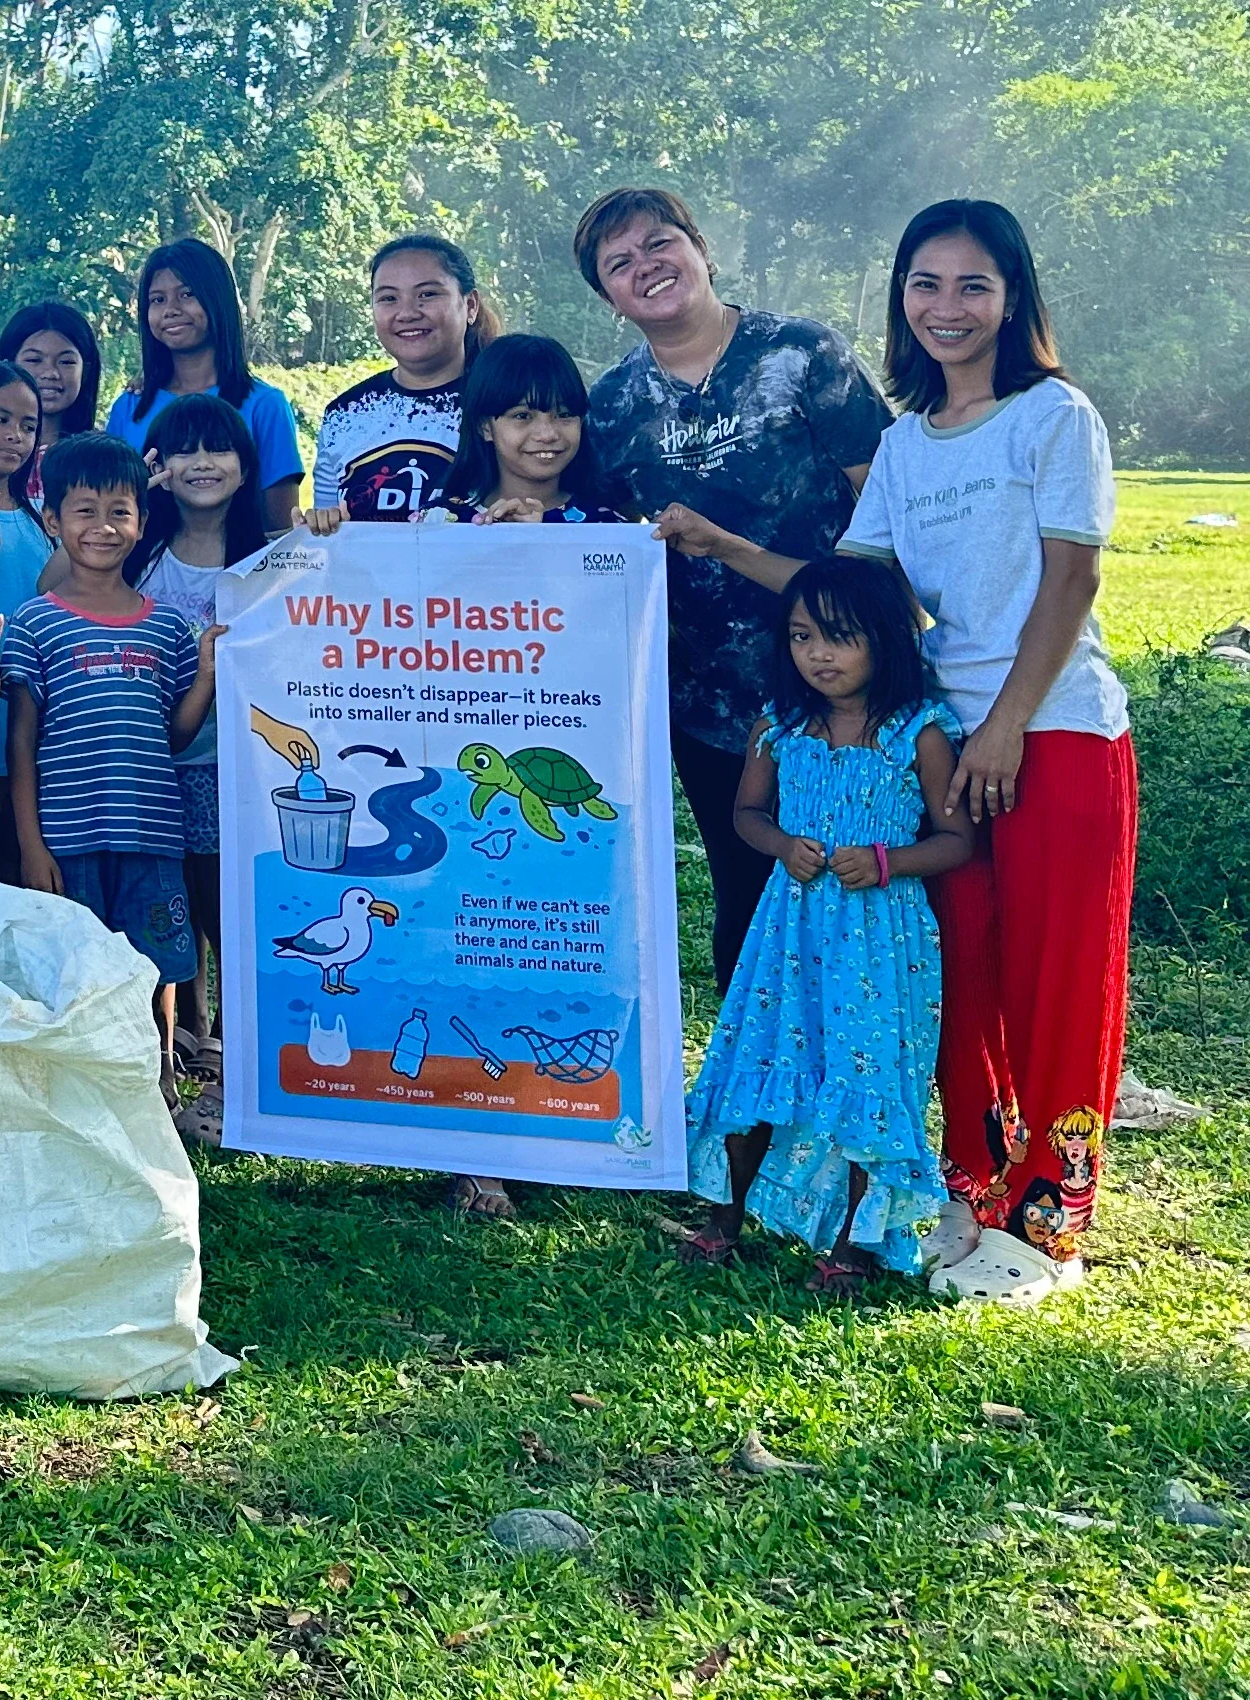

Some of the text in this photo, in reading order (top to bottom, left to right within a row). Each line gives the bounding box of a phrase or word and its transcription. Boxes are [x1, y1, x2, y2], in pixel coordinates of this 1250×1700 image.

[271, 552, 307, 560] OCEAN
[583, 553, 626, 564] KOMA
[285, 595, 565, 635] Why Is Plastic
[322, 638, 546, 675] a Problem?
[287, 682, 344, 698] Plastic
[349, 683, 415, 701] doesn’t
[541, 689, 601, 707] breaks
[309, 703, 587, 730] into smaller and smaller pieces.
[462, 894, 610, 915] Even if we can’t see
[455, 912, 600, 934] it anymore, it’s still
[455, 933, 604, 954] there and can harm
[456, 952, 605, 974] animals and nature.
[305, 1078, 355, 1092] ~20 years
[376, 1086, 434, 1098] ~450 years
[455, 1091, 516, 1105] ~500 years
[539, 1098, 600, 1112] ~600 years
